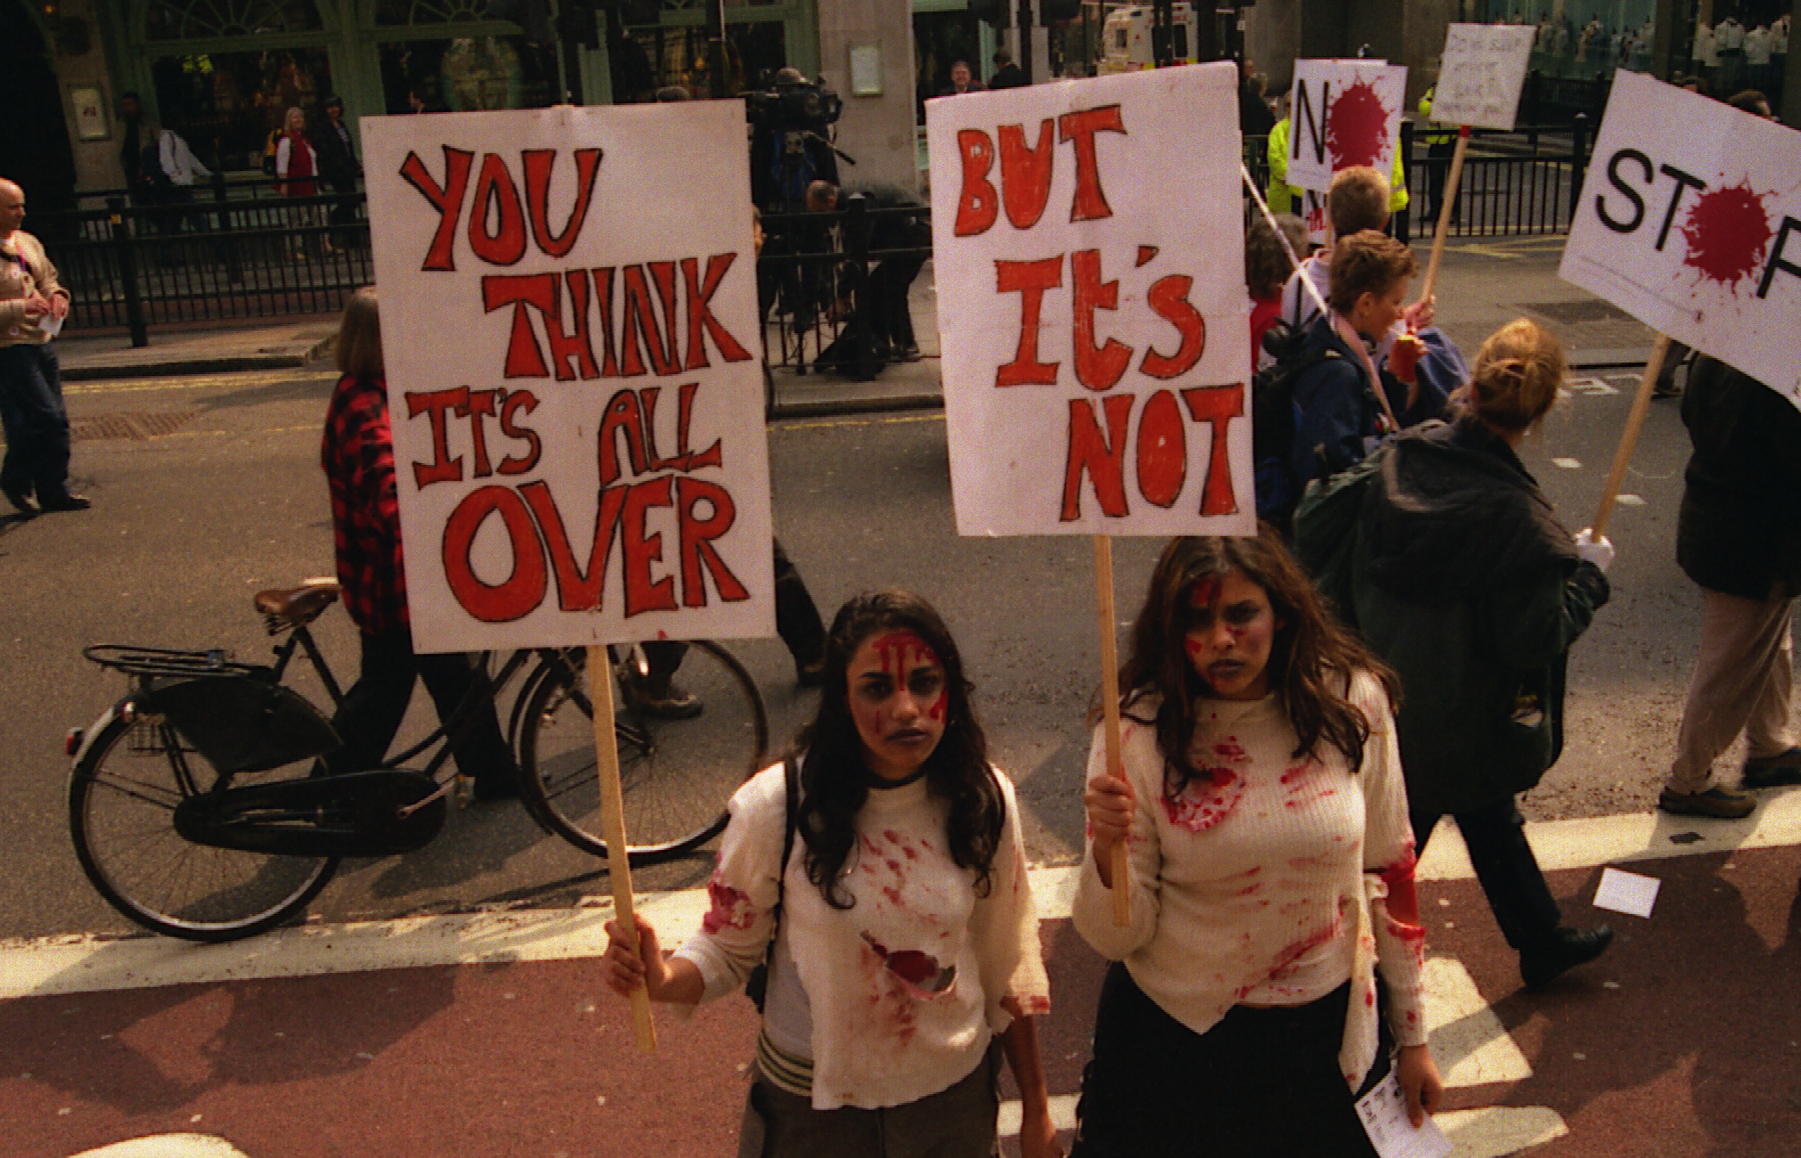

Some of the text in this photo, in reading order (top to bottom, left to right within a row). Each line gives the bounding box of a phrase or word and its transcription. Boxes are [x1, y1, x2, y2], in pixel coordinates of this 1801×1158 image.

[399, 144, 603, 271] YOU
[954, 104, 1127, 237] BUT
[482, 253, 753, 381] THINK
[404, 383, 722, 490] IT'S ALL
[1059, 382, 1244, 522] NOT
[442, 474, 750, 622] OVER
